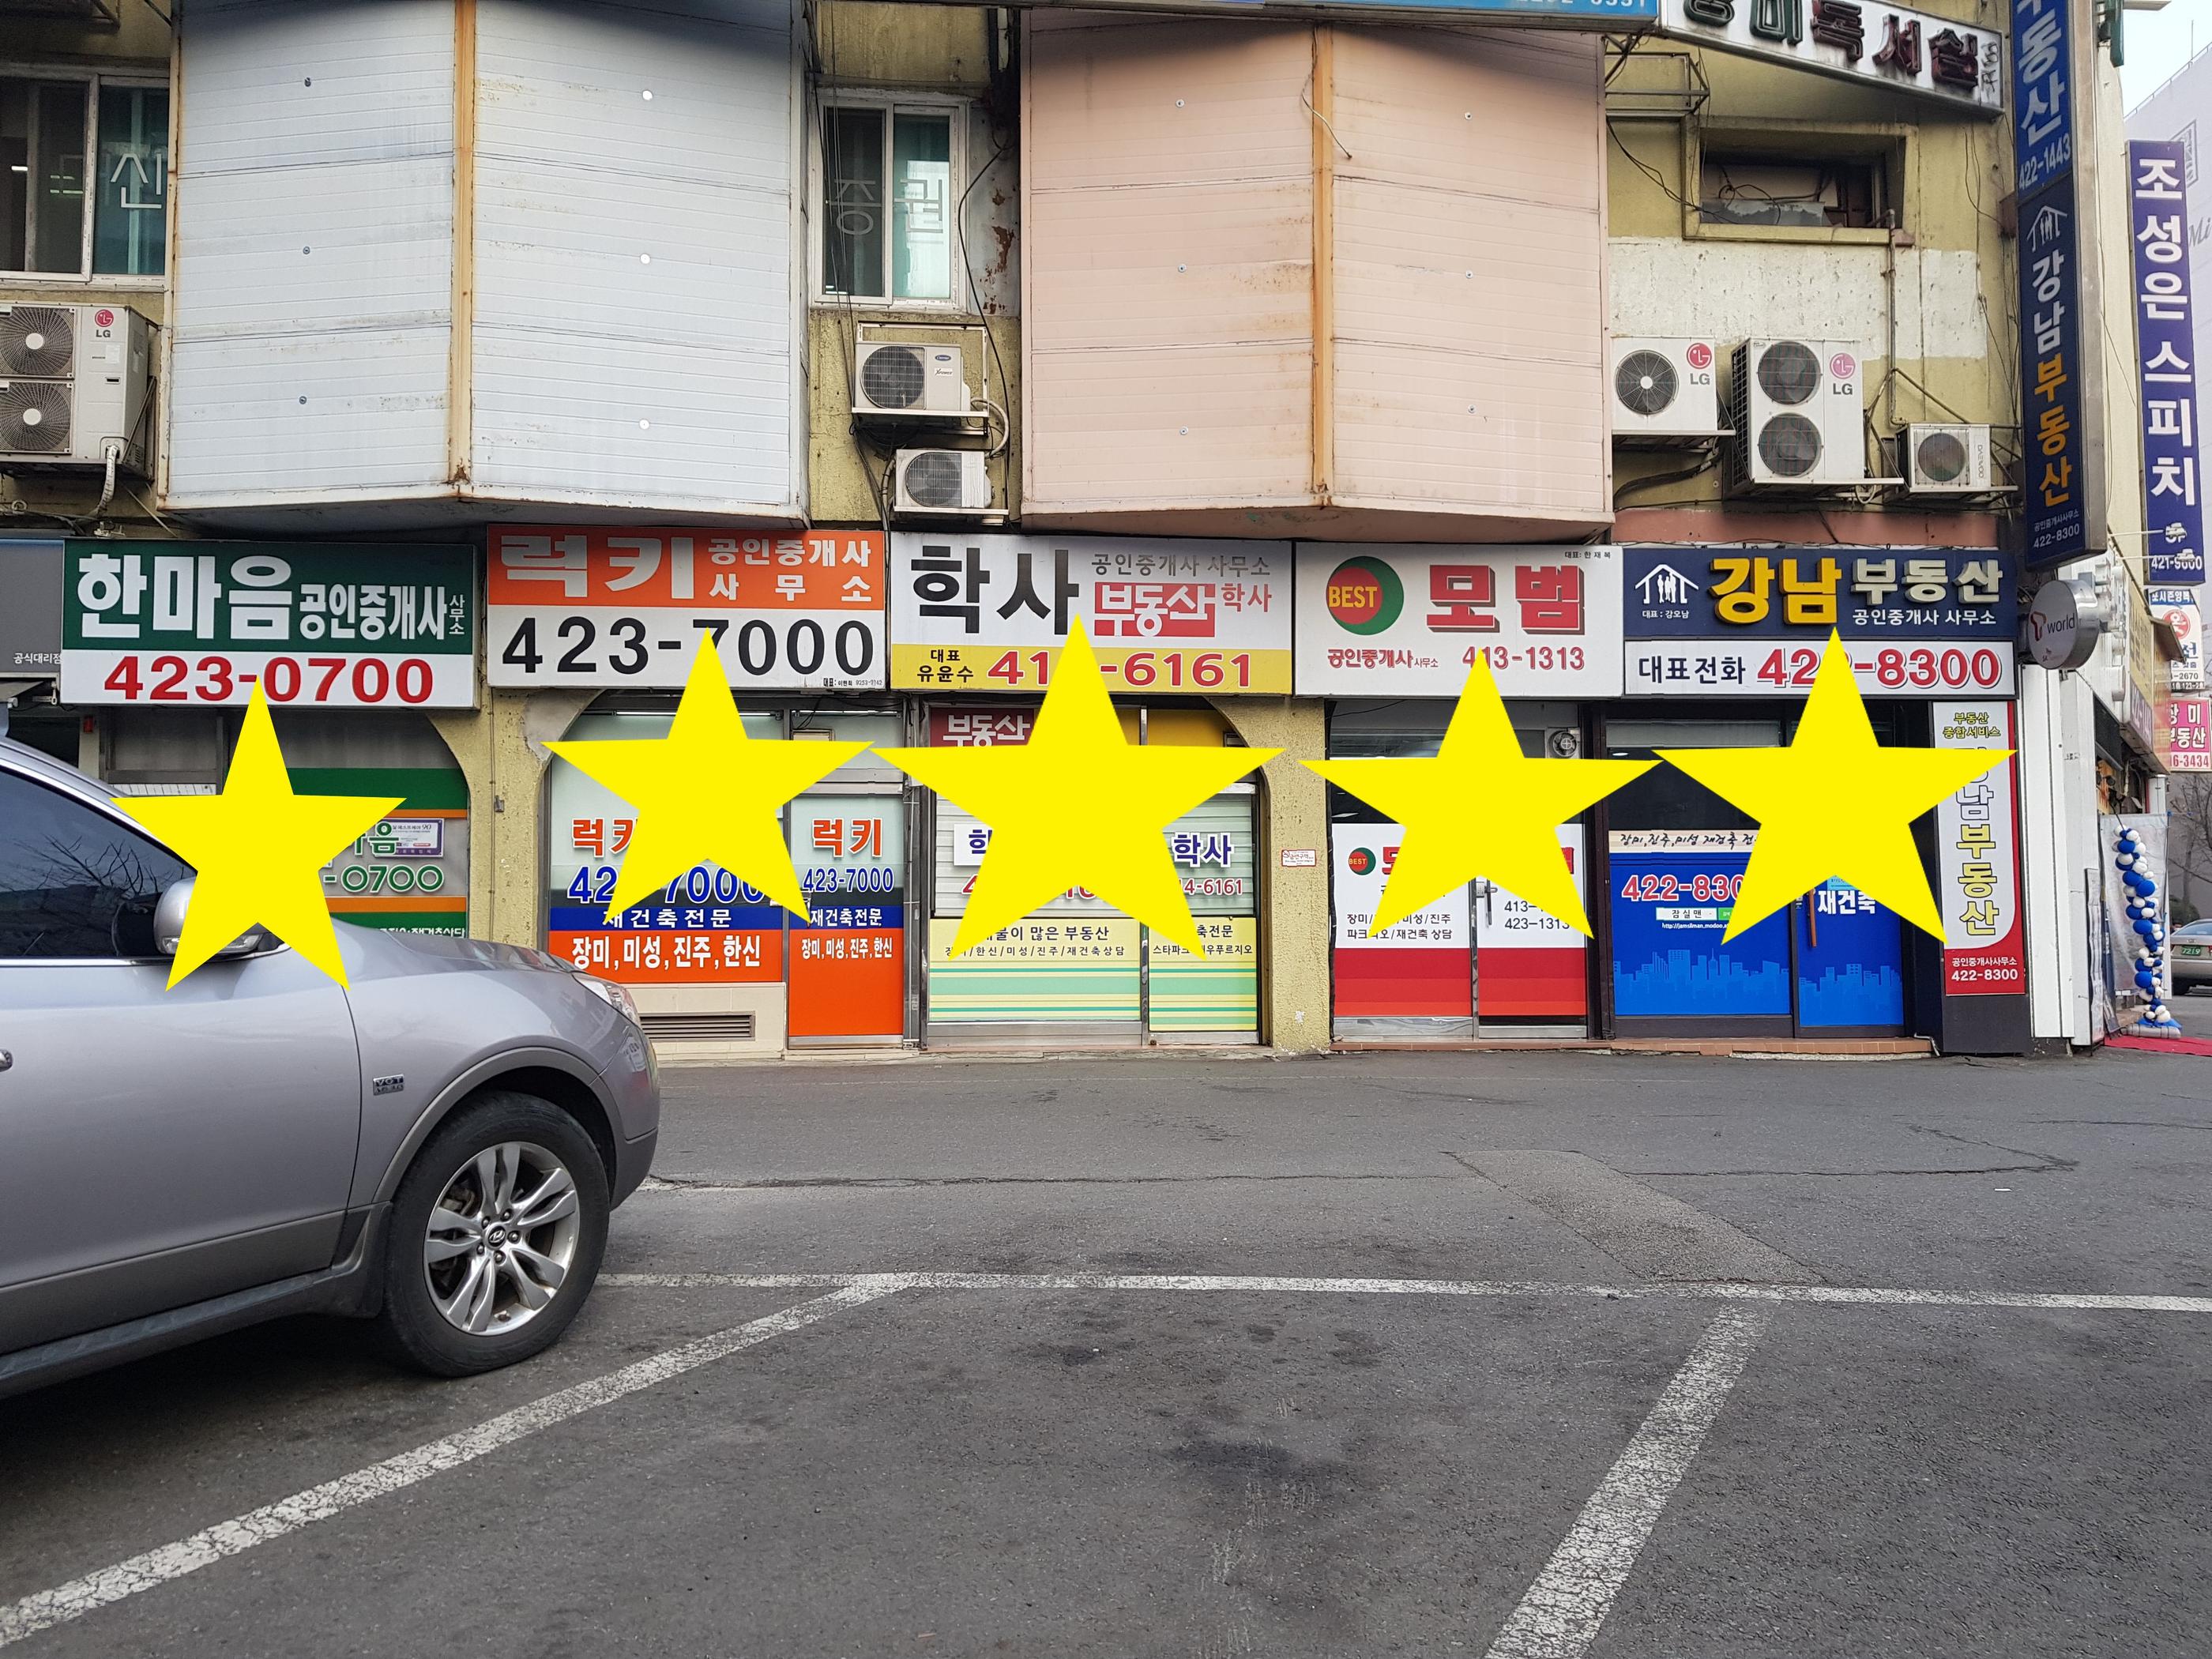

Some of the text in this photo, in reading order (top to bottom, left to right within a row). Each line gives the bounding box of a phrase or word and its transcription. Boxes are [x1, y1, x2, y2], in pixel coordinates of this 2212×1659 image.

[1683, 0, 1979, 89] 미독서실
[2017, 0, 2067, 147] 동산
[2019, 134, 2071, 190] 422-1443
[2135, 158, 2188, 320] 조성은
[96, 329, 111, 338] LG
[1689, 372, 1710, 386] LG
[1832, 382, 1853, 396] LG
[2145, 340, 2196, 506] 스피치
[2033, 523, 2080, 548] 422-8300
[708, 538, 871, 567] 공인중개사
[1091, 553, 1271, 577] 공인중개사 사무소
[501, 535, 695, 600] 럭키
[709, 574, 872, 602] 사무소
[911, 545, 1080, 635] 학사
[1708, 557, 1843, 626] 강남
[1850, 558, 2003, 605] 부동산
[77, 553, 465, 641] 한마음 공인중개사 사무소
[1221, 581, 1273, 613] 학사
[1328, 585, 1378, 608] BEST
[1427, 565, 1586, 636] 모범
[1094, 583, 1216, 638] 부동산
[1852, 608, 1997, 626] 공인중개사 사무소
[2048, 613, 2075, 634] world
[13, 653, 62, 664] 공식대리점
[502, 616, 874, 675] 423-7000
[930, 649, 961, 662] 대표
[1327, 648, 1439, 669] 공인중개사 사무소
[1462, 645, 1586, 671] 413-1313
[103, 655, 434, 703] 423-0700
[916, 665, 974, 683] 유윤수
[988, 650, 1252, 688] 41-6161
[1638, 656, 1746, 685] 대표전화
[1756, 647, 2003, 689] 42-8300
[942, 715, 1030, 747] 부동산
[1954, 712, 1989, 724] 부동산
[2170, 754, 2209, 767] 16-3434
[813, 818, 882, 857] 럭키
[1173, 833, 1232, 866] 학사
[1742, 833, 1759, 845] 전
[323, 866, 443, 893] -0700
[803, 867, 894, 893] 423-7000
[1179, 878, 1243, 895] 4-6161
[1622, 875, 1744, 901] 422-830
[811, 908, 882, 927] 재건축전문
[988, 927, 1110, 941] 물이 많은 부동산
[1196, 925, 1233, 938] 축전문
[1347, 929, 1453, 940] 파크오/재건축 상담
[1952, 957, 2018, 967] 공인중개사사무소
[1951, 969, 2018, 982] 422-8300
